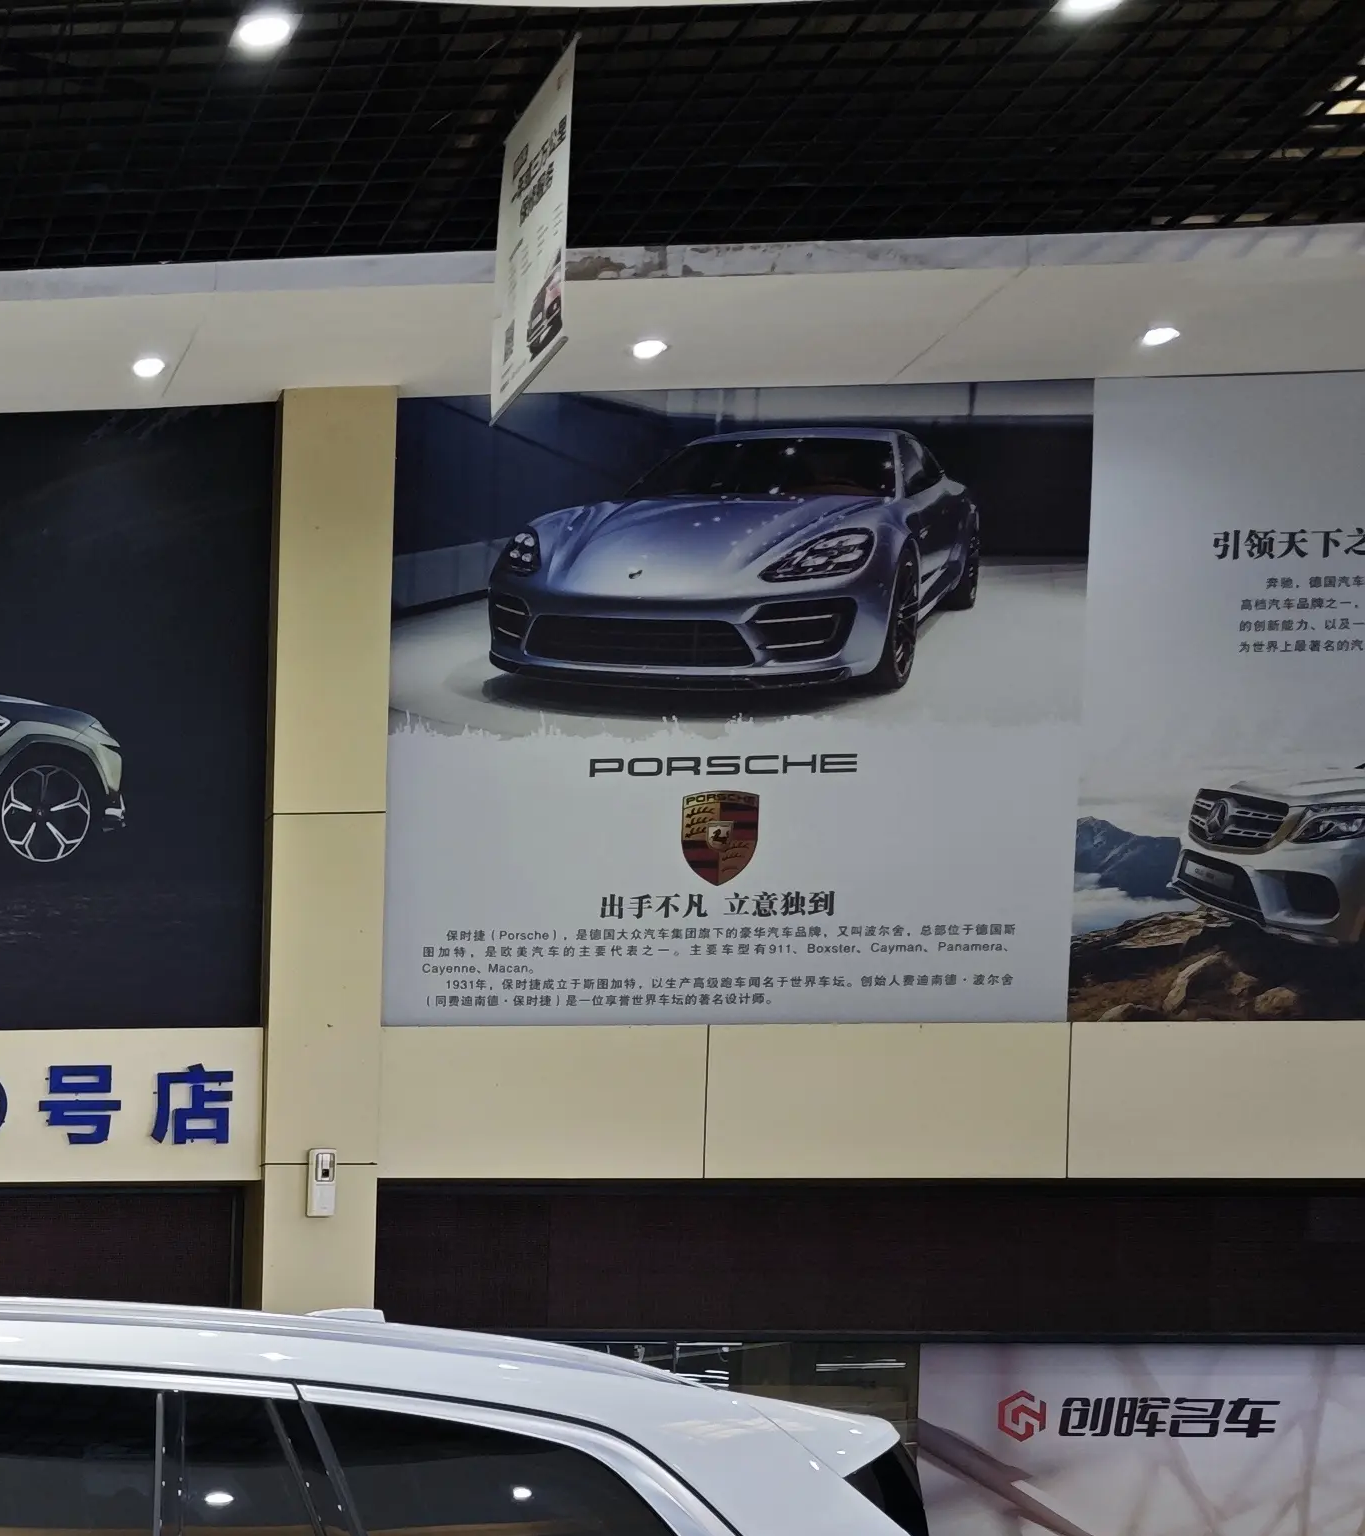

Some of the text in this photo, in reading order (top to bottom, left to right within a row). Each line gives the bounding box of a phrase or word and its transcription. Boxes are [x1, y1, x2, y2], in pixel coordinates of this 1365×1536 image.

[1212, 527, 1365, 560] 引领天下之
[589, 753, 858, 778] PORSCHE
[599, 890, 836, 920] 出手不凡 立意独到
[1058, 1396, 1281, 1438] 创晖名车
